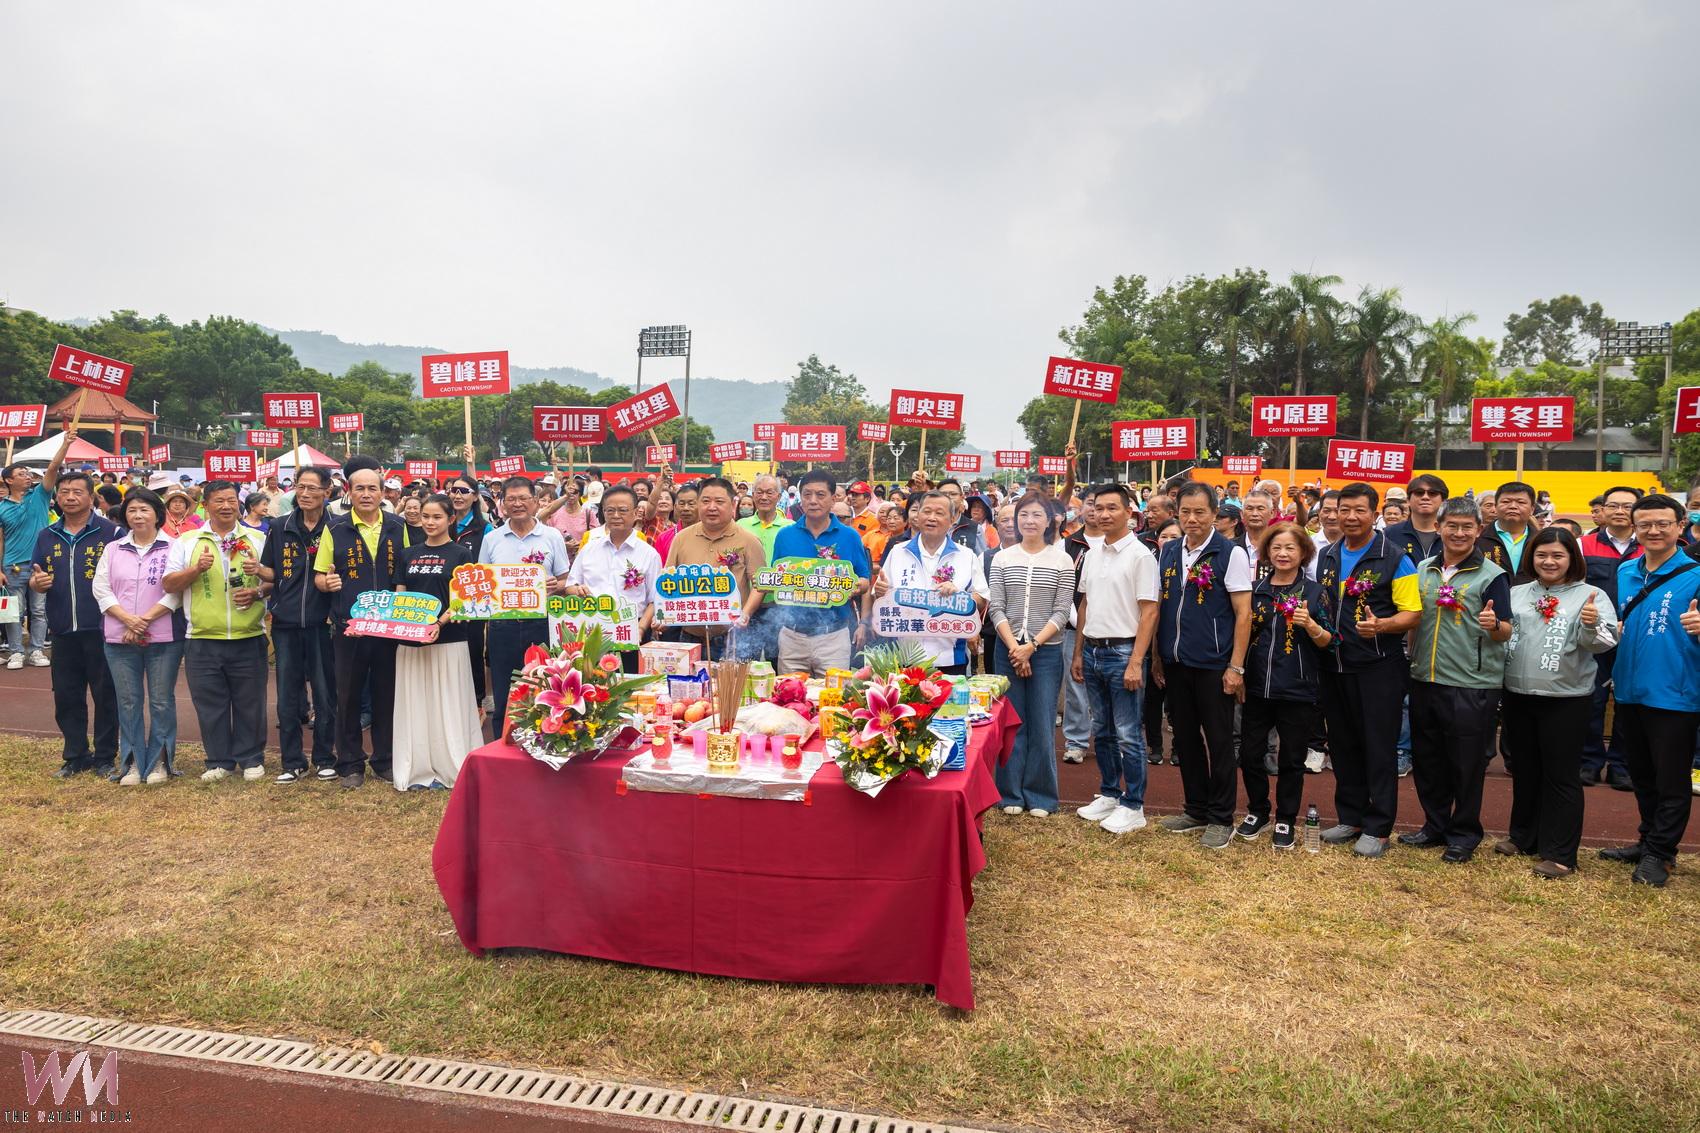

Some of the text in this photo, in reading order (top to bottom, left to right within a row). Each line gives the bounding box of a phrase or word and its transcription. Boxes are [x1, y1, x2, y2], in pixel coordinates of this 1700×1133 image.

[59, 353, 125, 387] 上林里
[430, 359, 501, 384] 碧峰里
[1052, 364, 1114, 391] 新庄里
[614, 391, 671, 429] 北投里
[897, 396, 956, 419] 御史里
[1260, 403, 1329, 425] 中原里
[541, 414, 600, 432] 石川里
[1480, 405, 1564, 429] 雙冬里
[781, 432, 839, 451] 加老里
[1120, 426, 1188, 449] 新豐里
[209, 456, 252, 473] 復興里
[1335, 447, 1406, 473] 平林里
[457, 568, 486, 584] 活力
[500, 567, 539, 577] 歡迎大家
[678, 566, 711, 576] 草屯鎮
[463, 582, 493, 597] 草屯
[505, 578, 534, 588] 一起來
[661, 576, 731, 594] 中山公園
[358, 591, 392, 608] 草屯
[502, 590, 537, 608] 運動
[549, 596, 614, 612] 中山公園
[665, 599, 731, 612] 設施改善工程
[899, 588, 969, 612] 南投縣政府
[391, 607, 426, 623] 好地方
[676, 611, 720, 623] 竣工典禮
[879, 606, 902, 617] 縣長
[1657, 591, 1673, 634] 南投縣政府
[879, 619, 976, 633] 許淑華 補助經費
[1540, 617, 1567, 672] 洪巧娟
